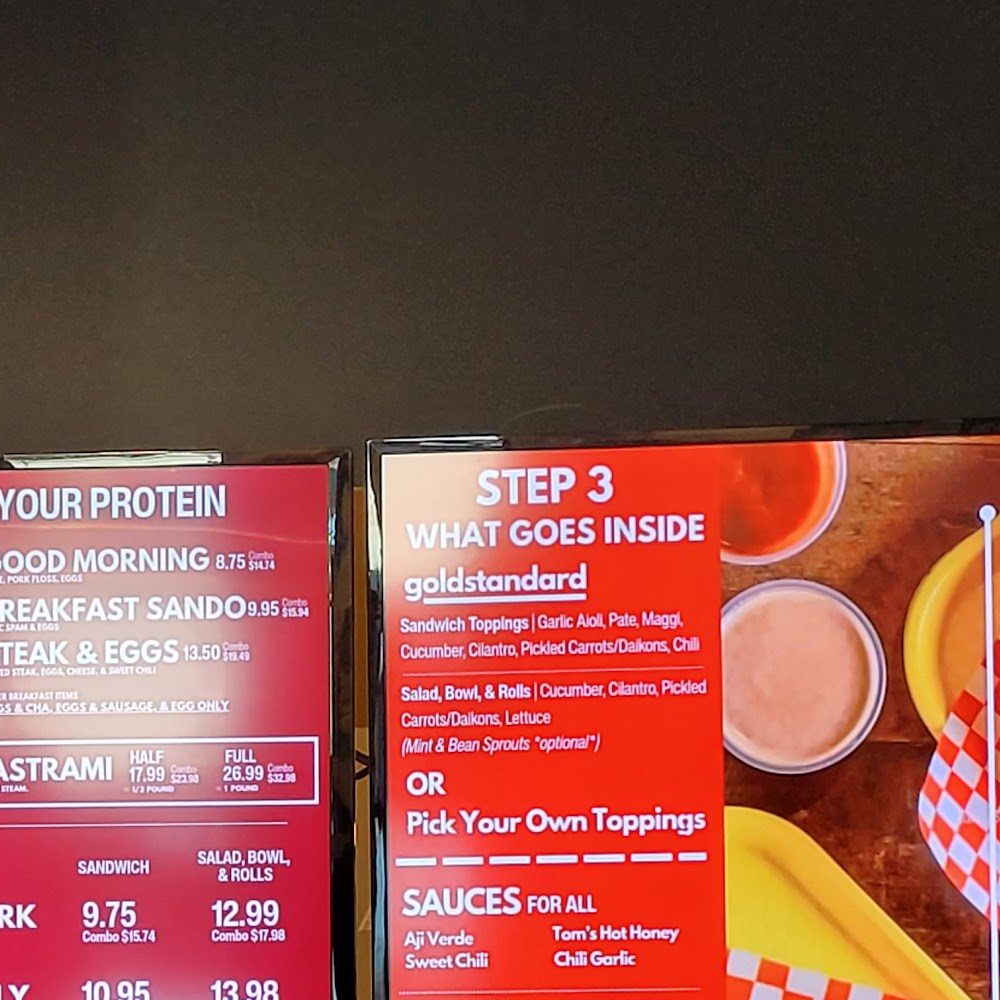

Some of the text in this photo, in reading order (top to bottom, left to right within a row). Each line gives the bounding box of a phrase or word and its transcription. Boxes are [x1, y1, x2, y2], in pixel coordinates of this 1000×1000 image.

[477, 465, 614, 506] STEP 3
[90, 484, 227, 519] PROTEIN
[406, 515, 705, 549] WHAT GOES INSIDE
[73, 547, 210, 573] MORNING
[215, 554, 246, 571] 8.75
[7, 575, 29, 584] PORK
[61, 574, 83, 583] EGGS
[404, 563, 587, 602] goldstandard
[146, 595, 247, 620] SANDO
[247, 601, 279, 616] 9.95
[77, 642, 98, 664] &
[104, 640, 179, 663] EGGS
[183, 645, 220, 661] 13.50
[435, 738, 445, 753] &
[447, 737, 480, 752] Bean
[482, 736, 530, 753] Sprouts
[129, 749, 165, 764] HALF
[225, 749, 257, 764] FULL
[129, 766, 165, 783] 17.99
[222, 764, 265, 781] 26.99
[406, 771, 446, 796] OR
[406, 807, 707, 836] Pick Your Own Toppings
[77, 860, 150, 875] SANDWICH
[198, 850, 291, 867] SALAD, BOWL,
[218, 867, 274, 882] & ROLLS
[401, 887, 597, 916] SAUCES FOR ALL
[82, 901, 137, 929] 9.75
[211, 899, 280, 928] 12.99
[404, 930, 475, 950] Aji Verde
[552, 925, 680, 943] Tom's Hot Honey
[405, 952, 489, 970] Sweet Chili
[554, 951, 636, 968] Chili Garlic
